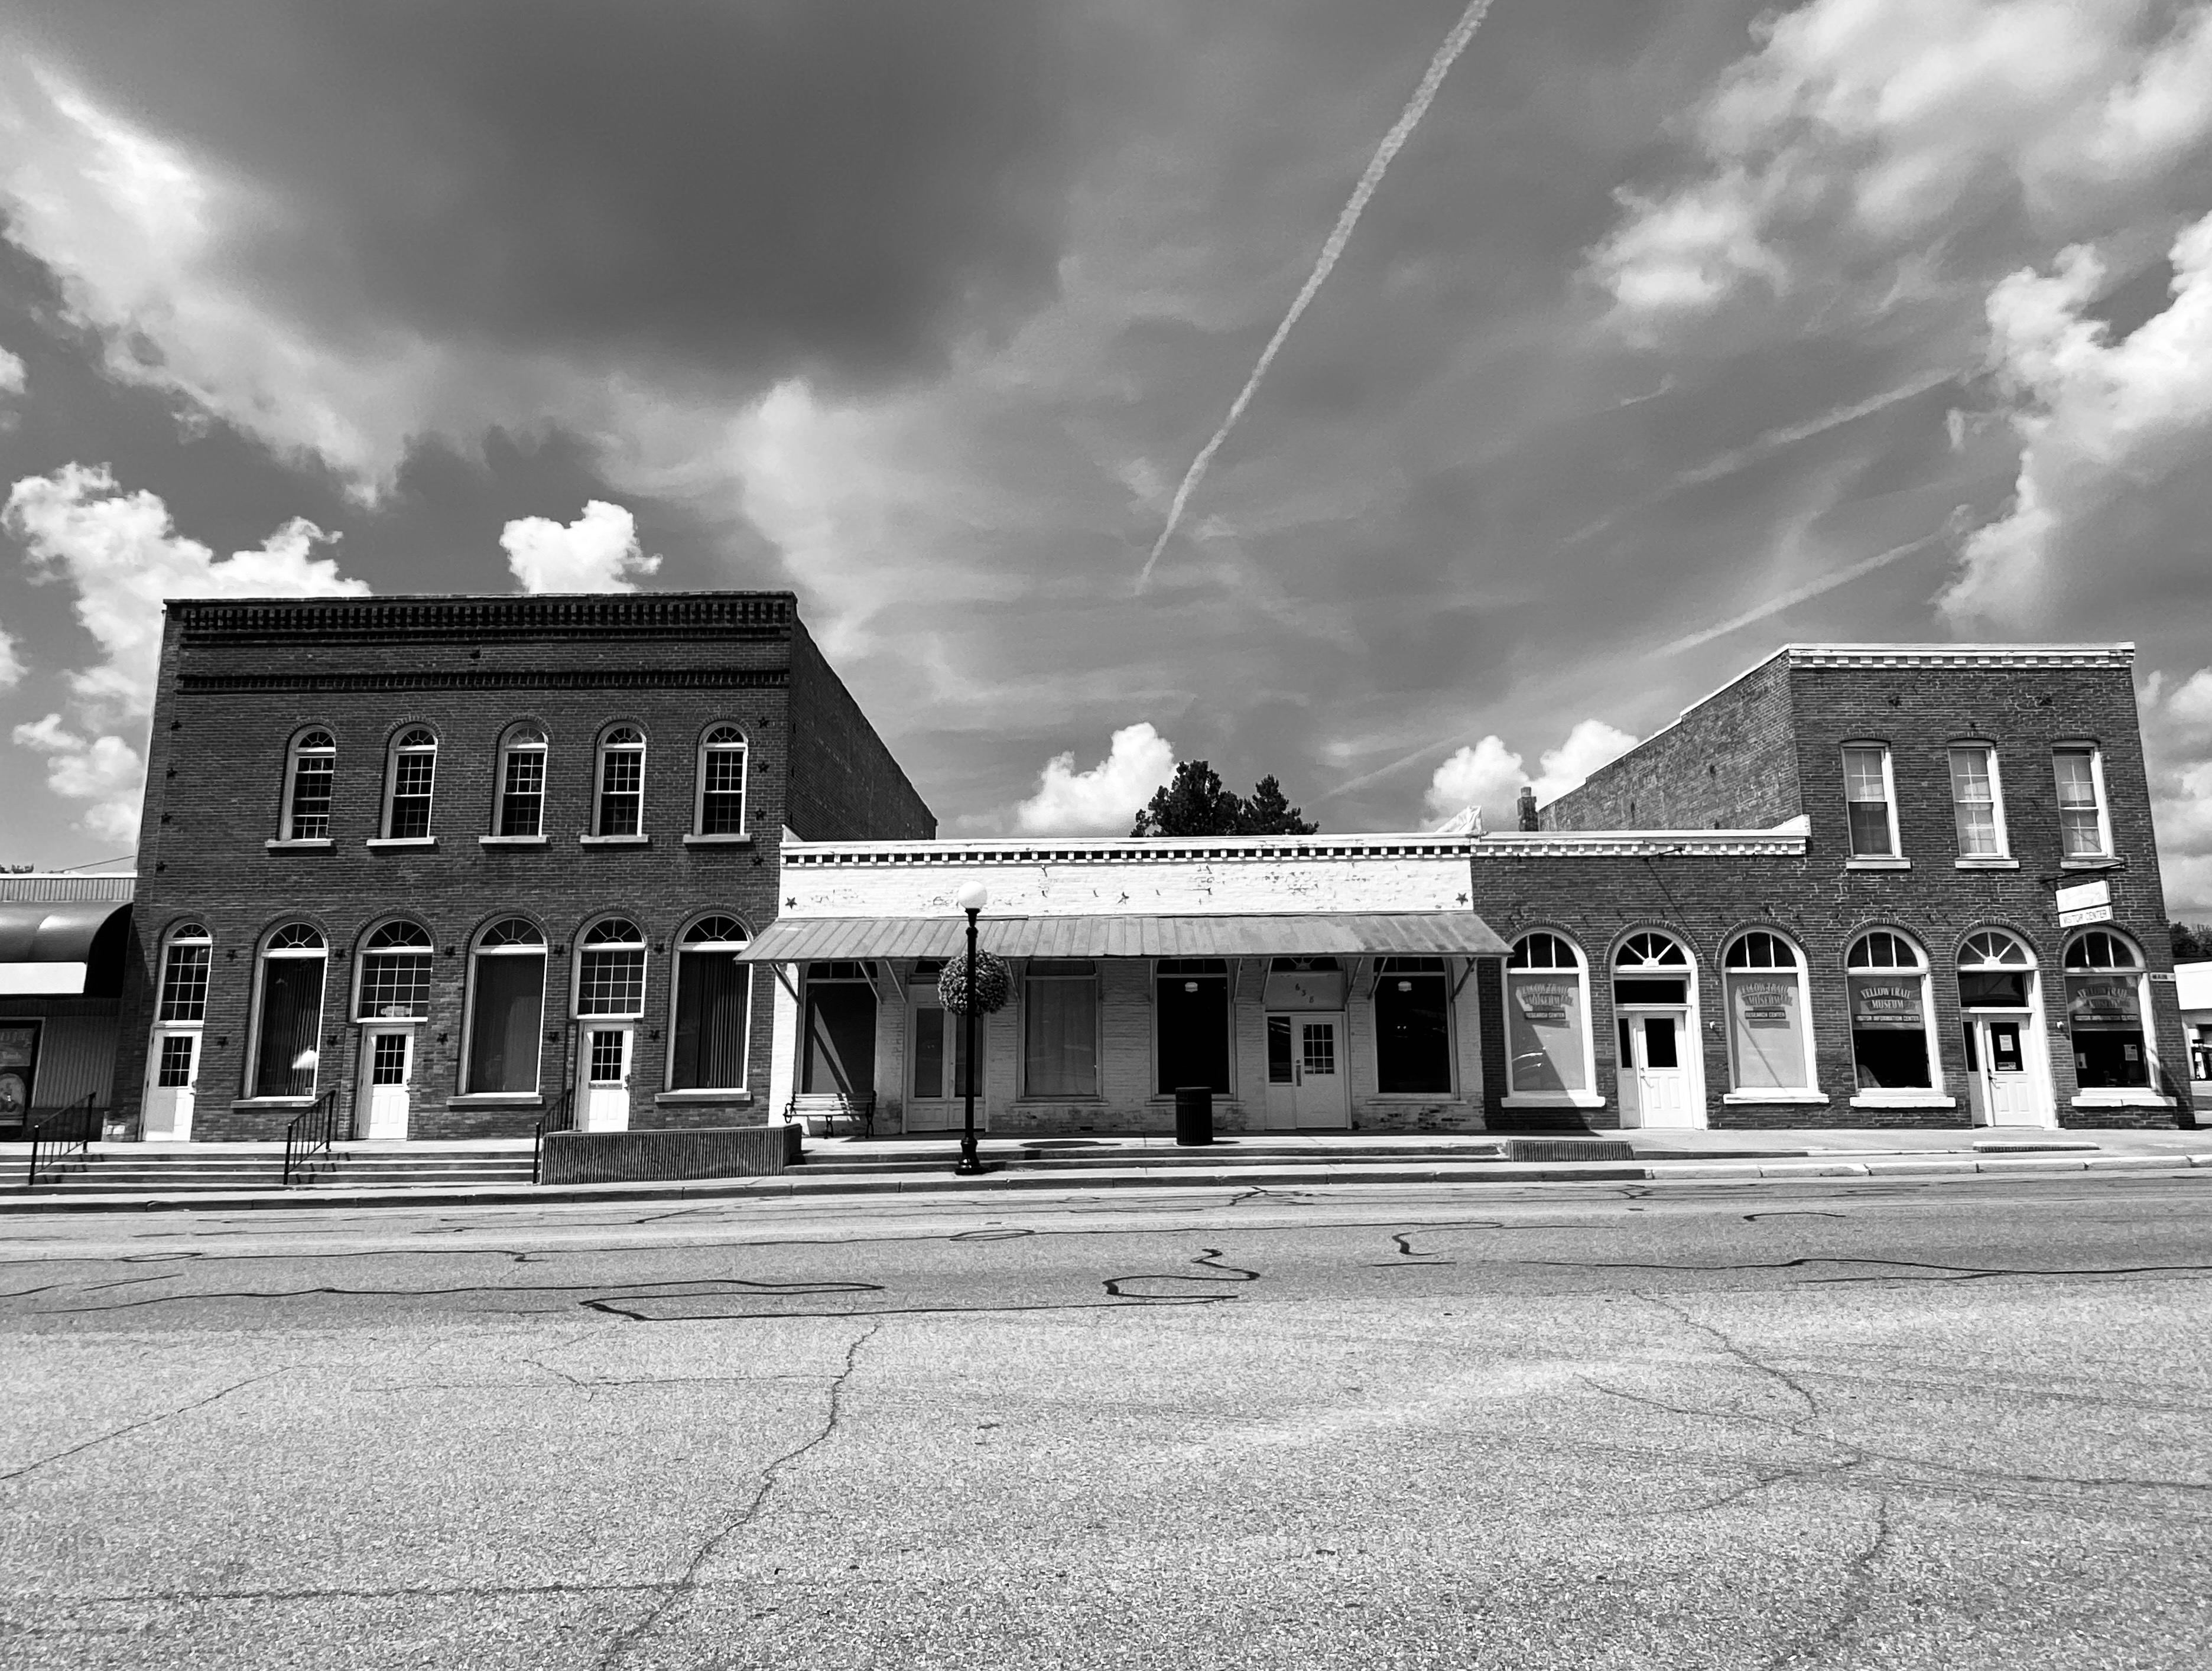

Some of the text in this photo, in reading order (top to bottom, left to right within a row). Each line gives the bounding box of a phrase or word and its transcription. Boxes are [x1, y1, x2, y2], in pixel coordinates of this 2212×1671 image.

[2062, 909, 2107, 924] VISITOR CENTER
[1860, 986, 1911, 999] YELLOW TRAIL
[1872, 999, 1904, 1009] MUSEUM
